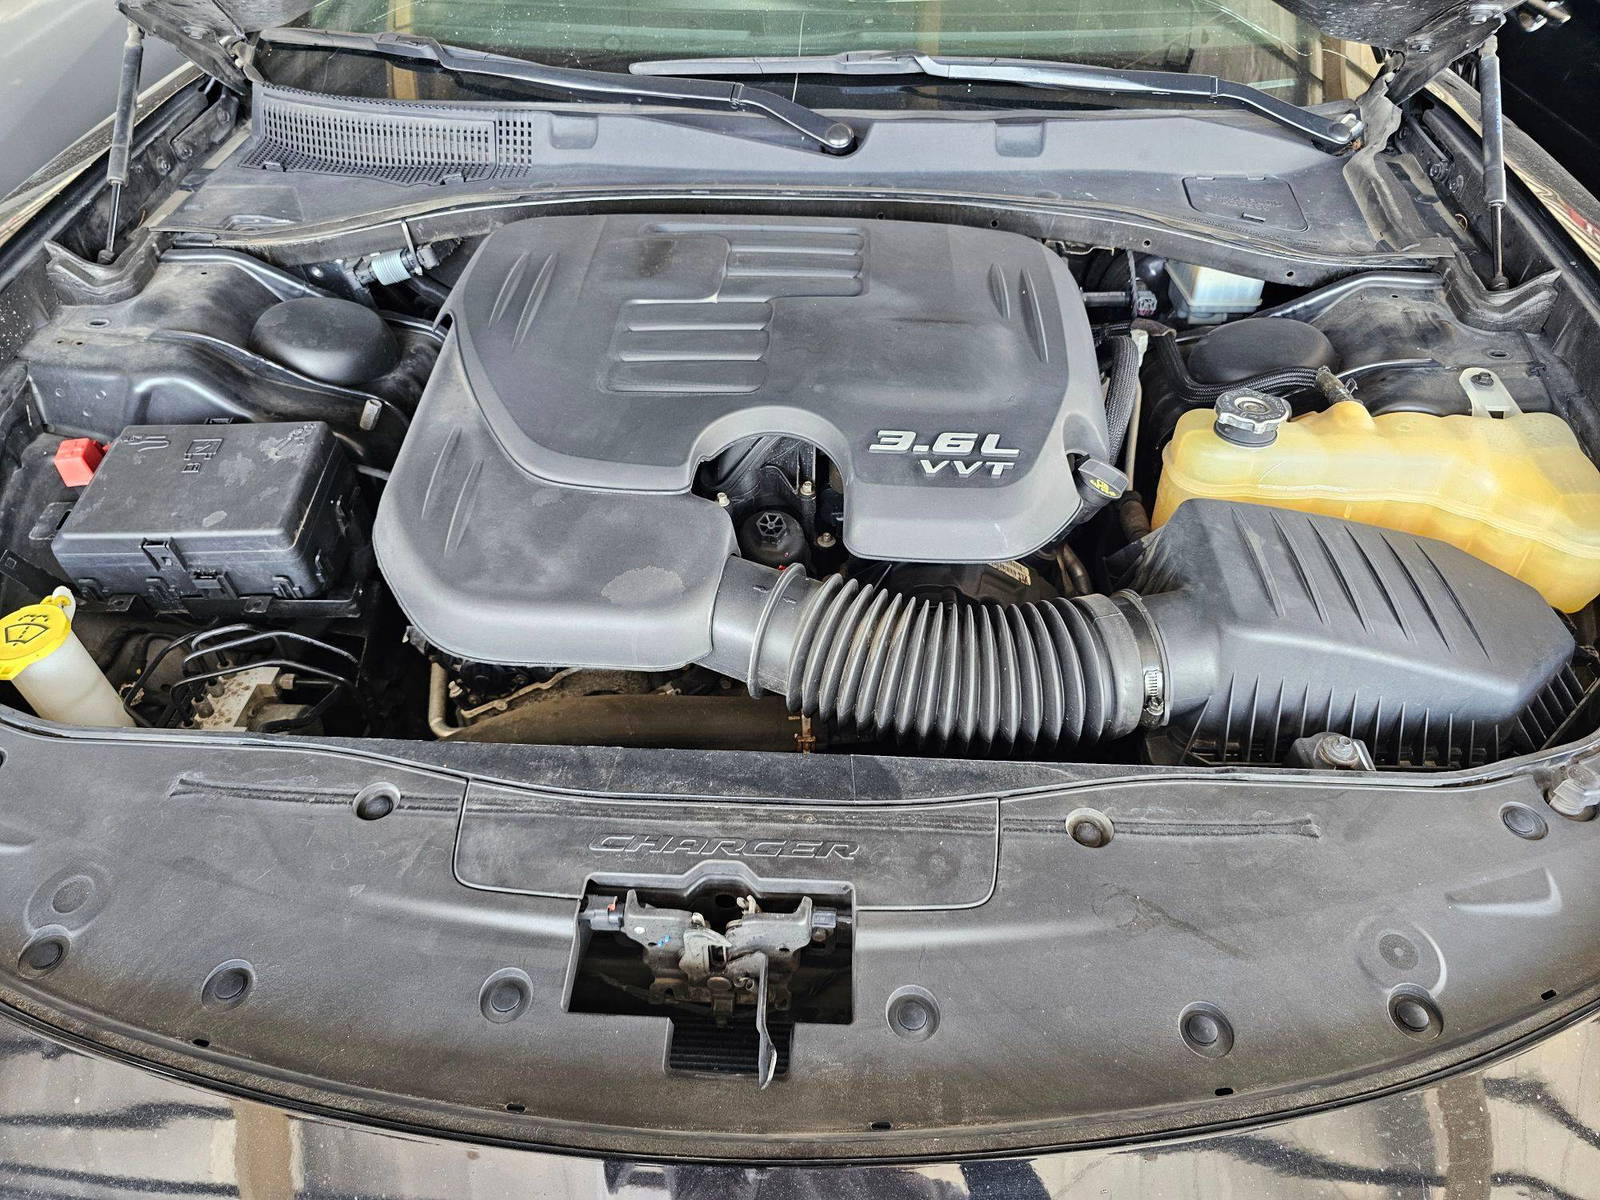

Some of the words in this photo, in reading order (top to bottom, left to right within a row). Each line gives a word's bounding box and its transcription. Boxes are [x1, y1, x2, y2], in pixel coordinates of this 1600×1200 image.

[868, 430, 1020, 457] 3.6L
[919, 459, 1016, 479] VVT
[588, 832, 861, 861] CHARGER
